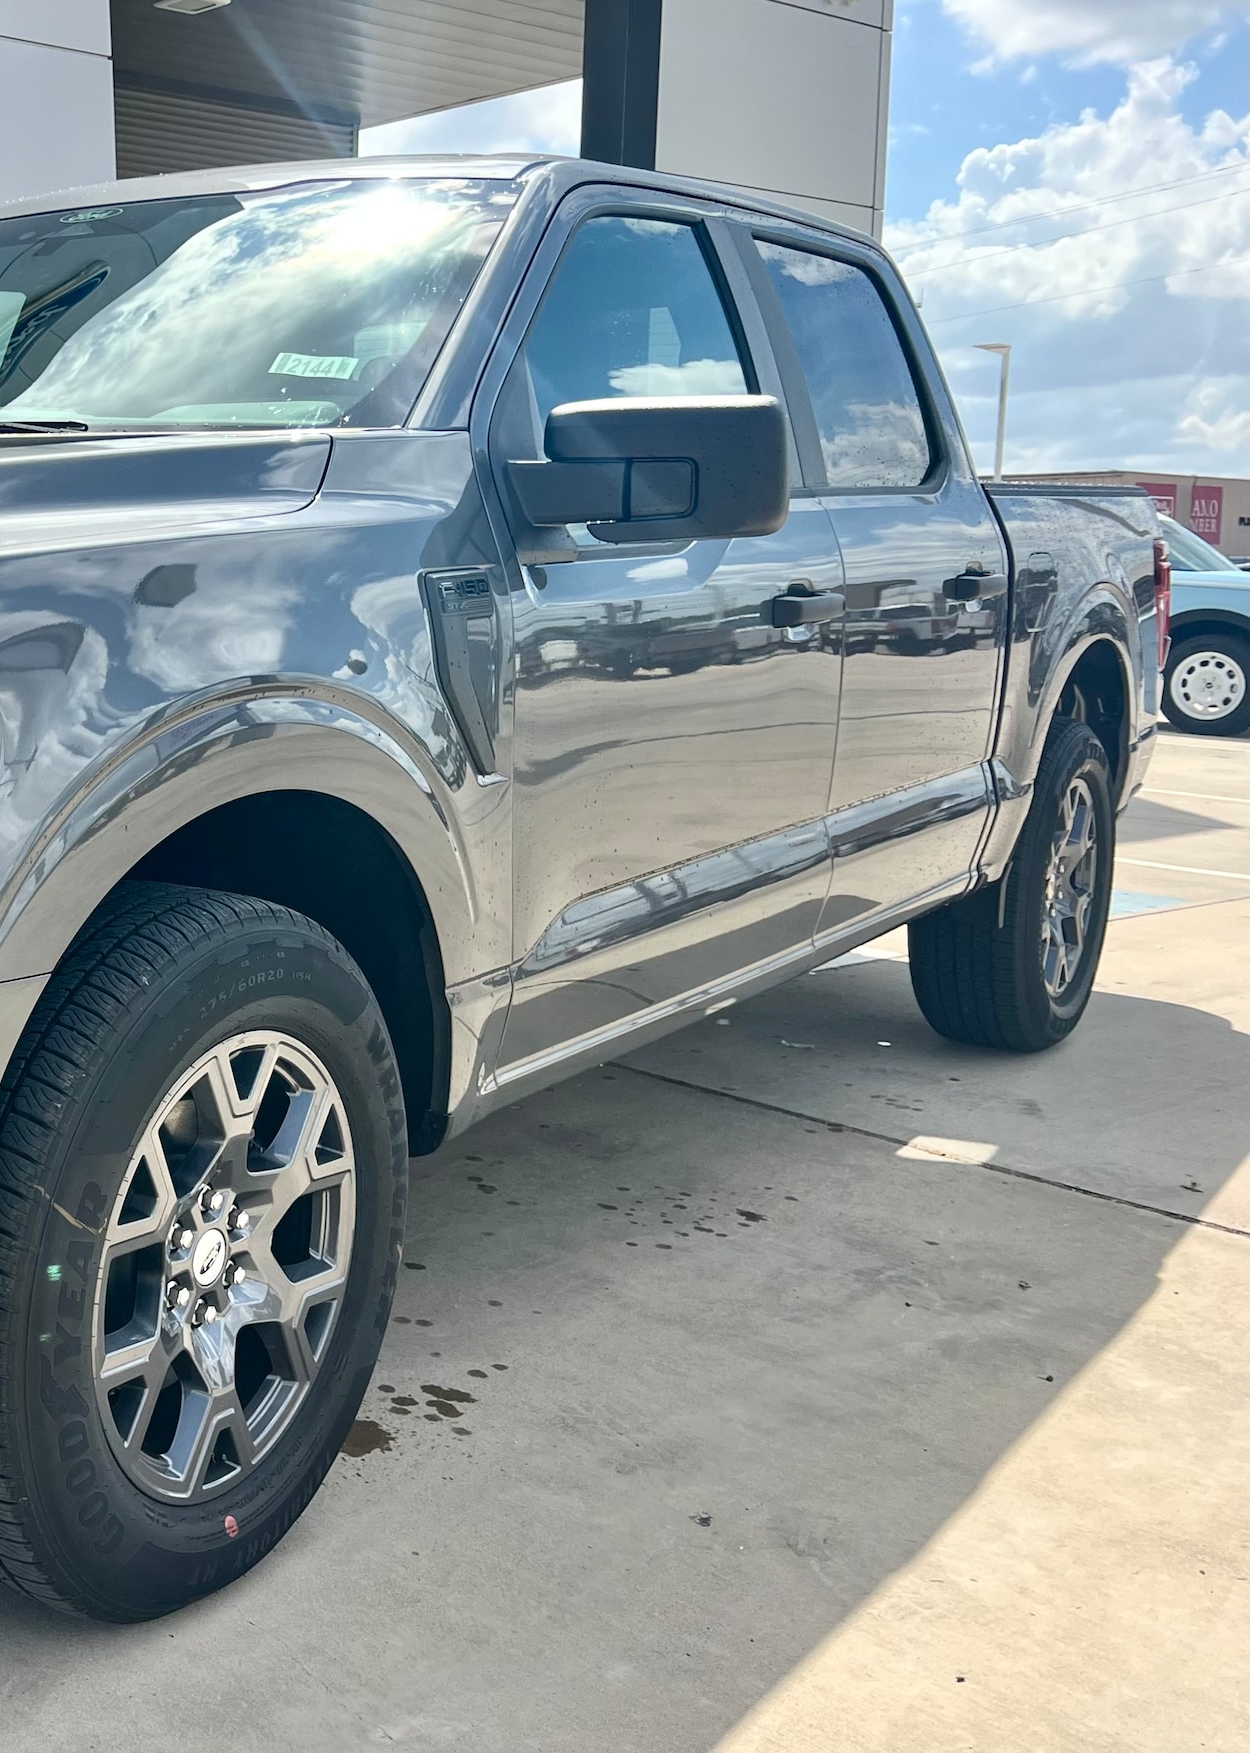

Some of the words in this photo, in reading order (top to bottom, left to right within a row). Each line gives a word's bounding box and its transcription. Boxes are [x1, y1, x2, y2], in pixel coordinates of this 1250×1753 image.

[439, 579, 490, 598] F-150
[199, 968, 284, 1020] 275/60R20
[39, 1180, 125, 1555] GOODYEAR
